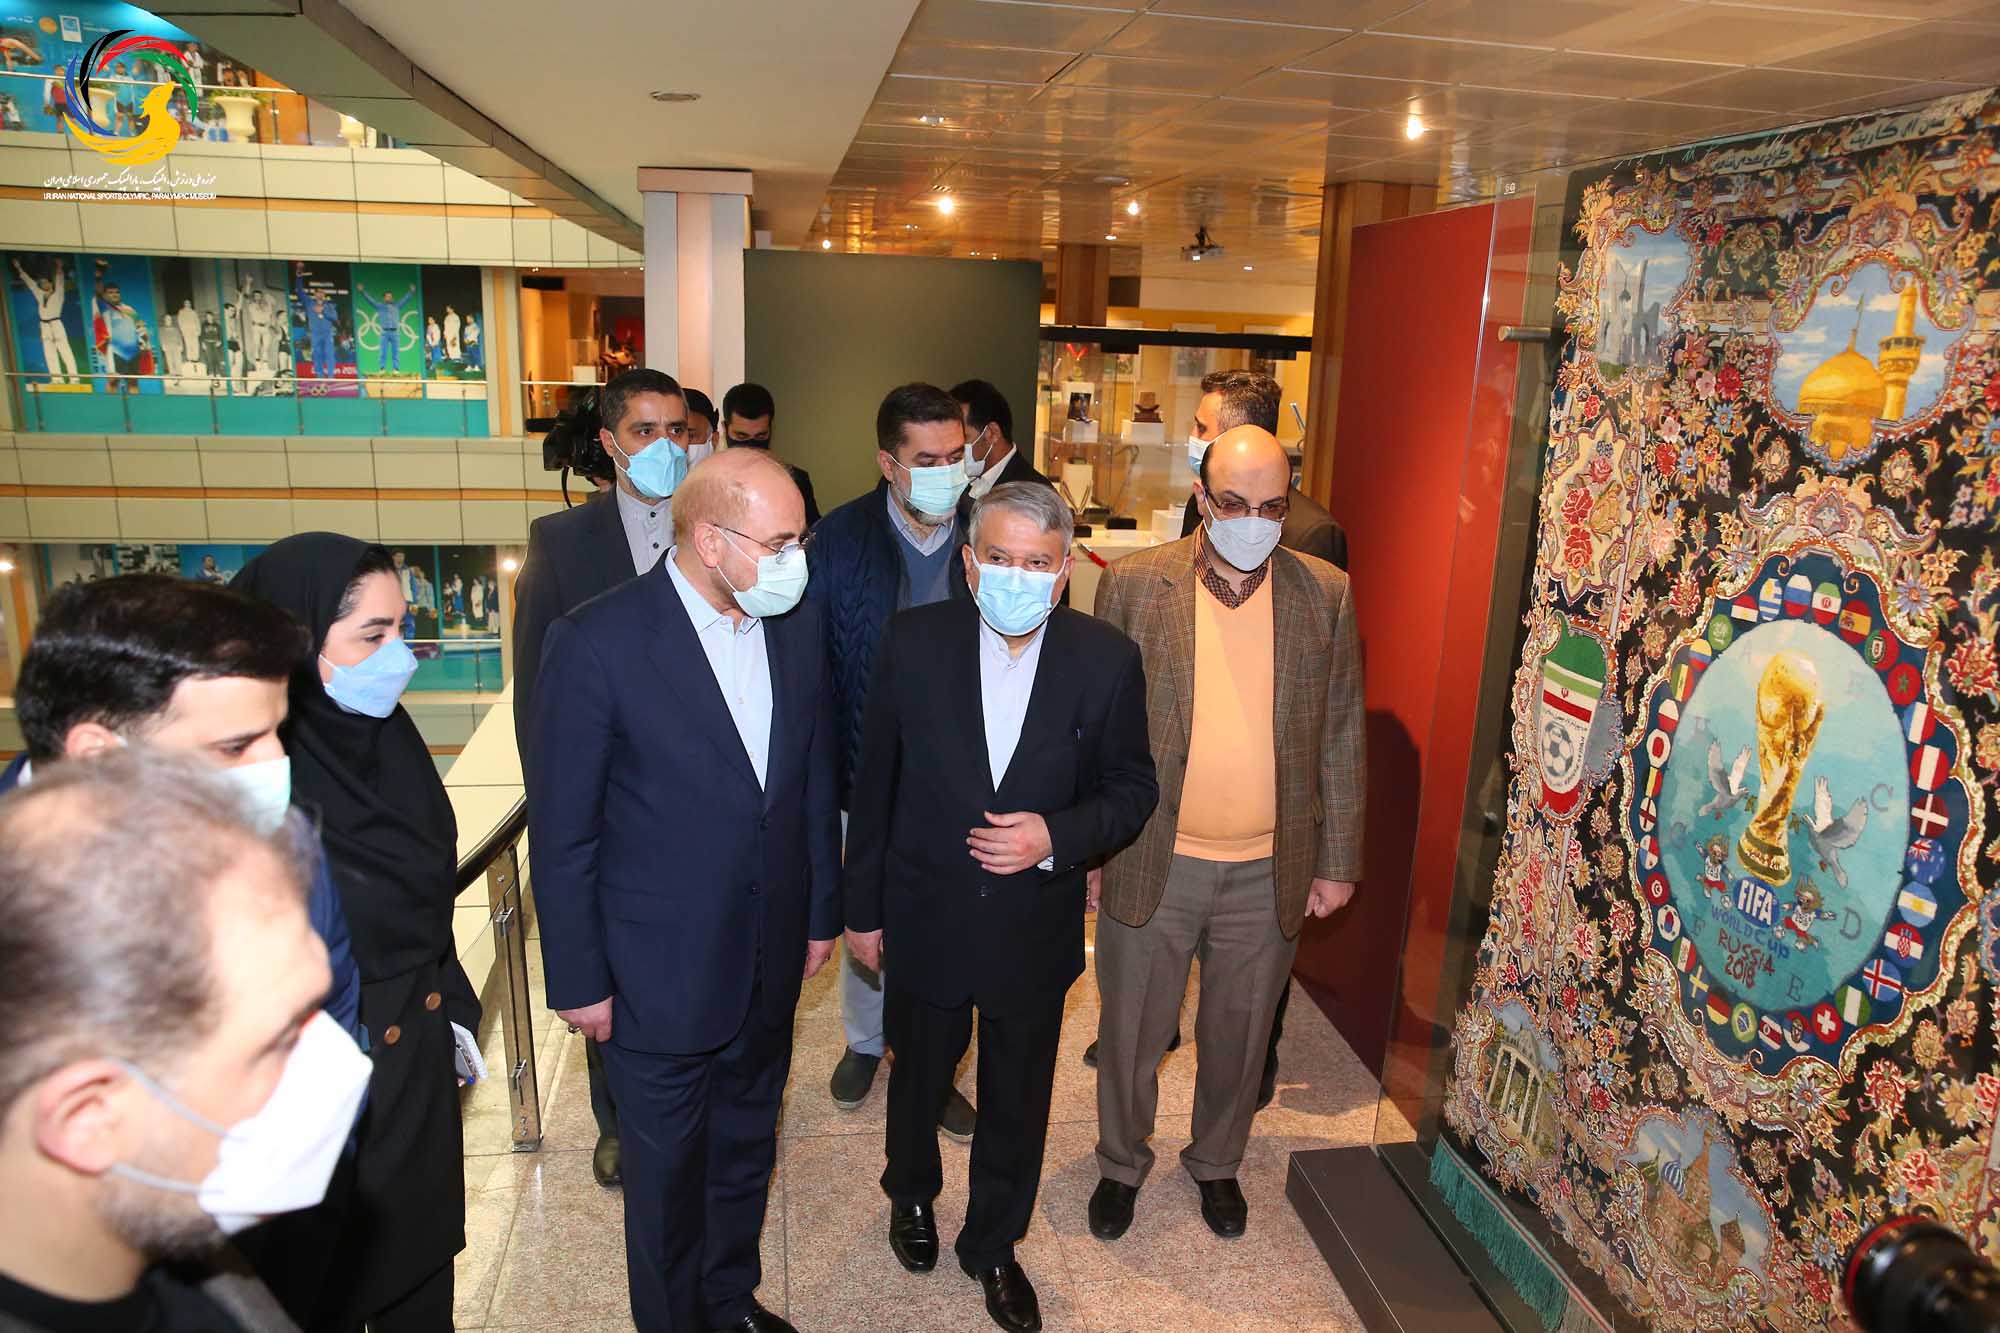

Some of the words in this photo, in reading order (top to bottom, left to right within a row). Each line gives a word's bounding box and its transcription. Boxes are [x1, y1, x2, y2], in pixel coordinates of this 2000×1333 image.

[1871, 783, 1894, 812] C
[1738, 879, 1773, 925] FIFA
[1840, 907, 1862, 940] D
[1725, 954, 1755, 989] 2018
